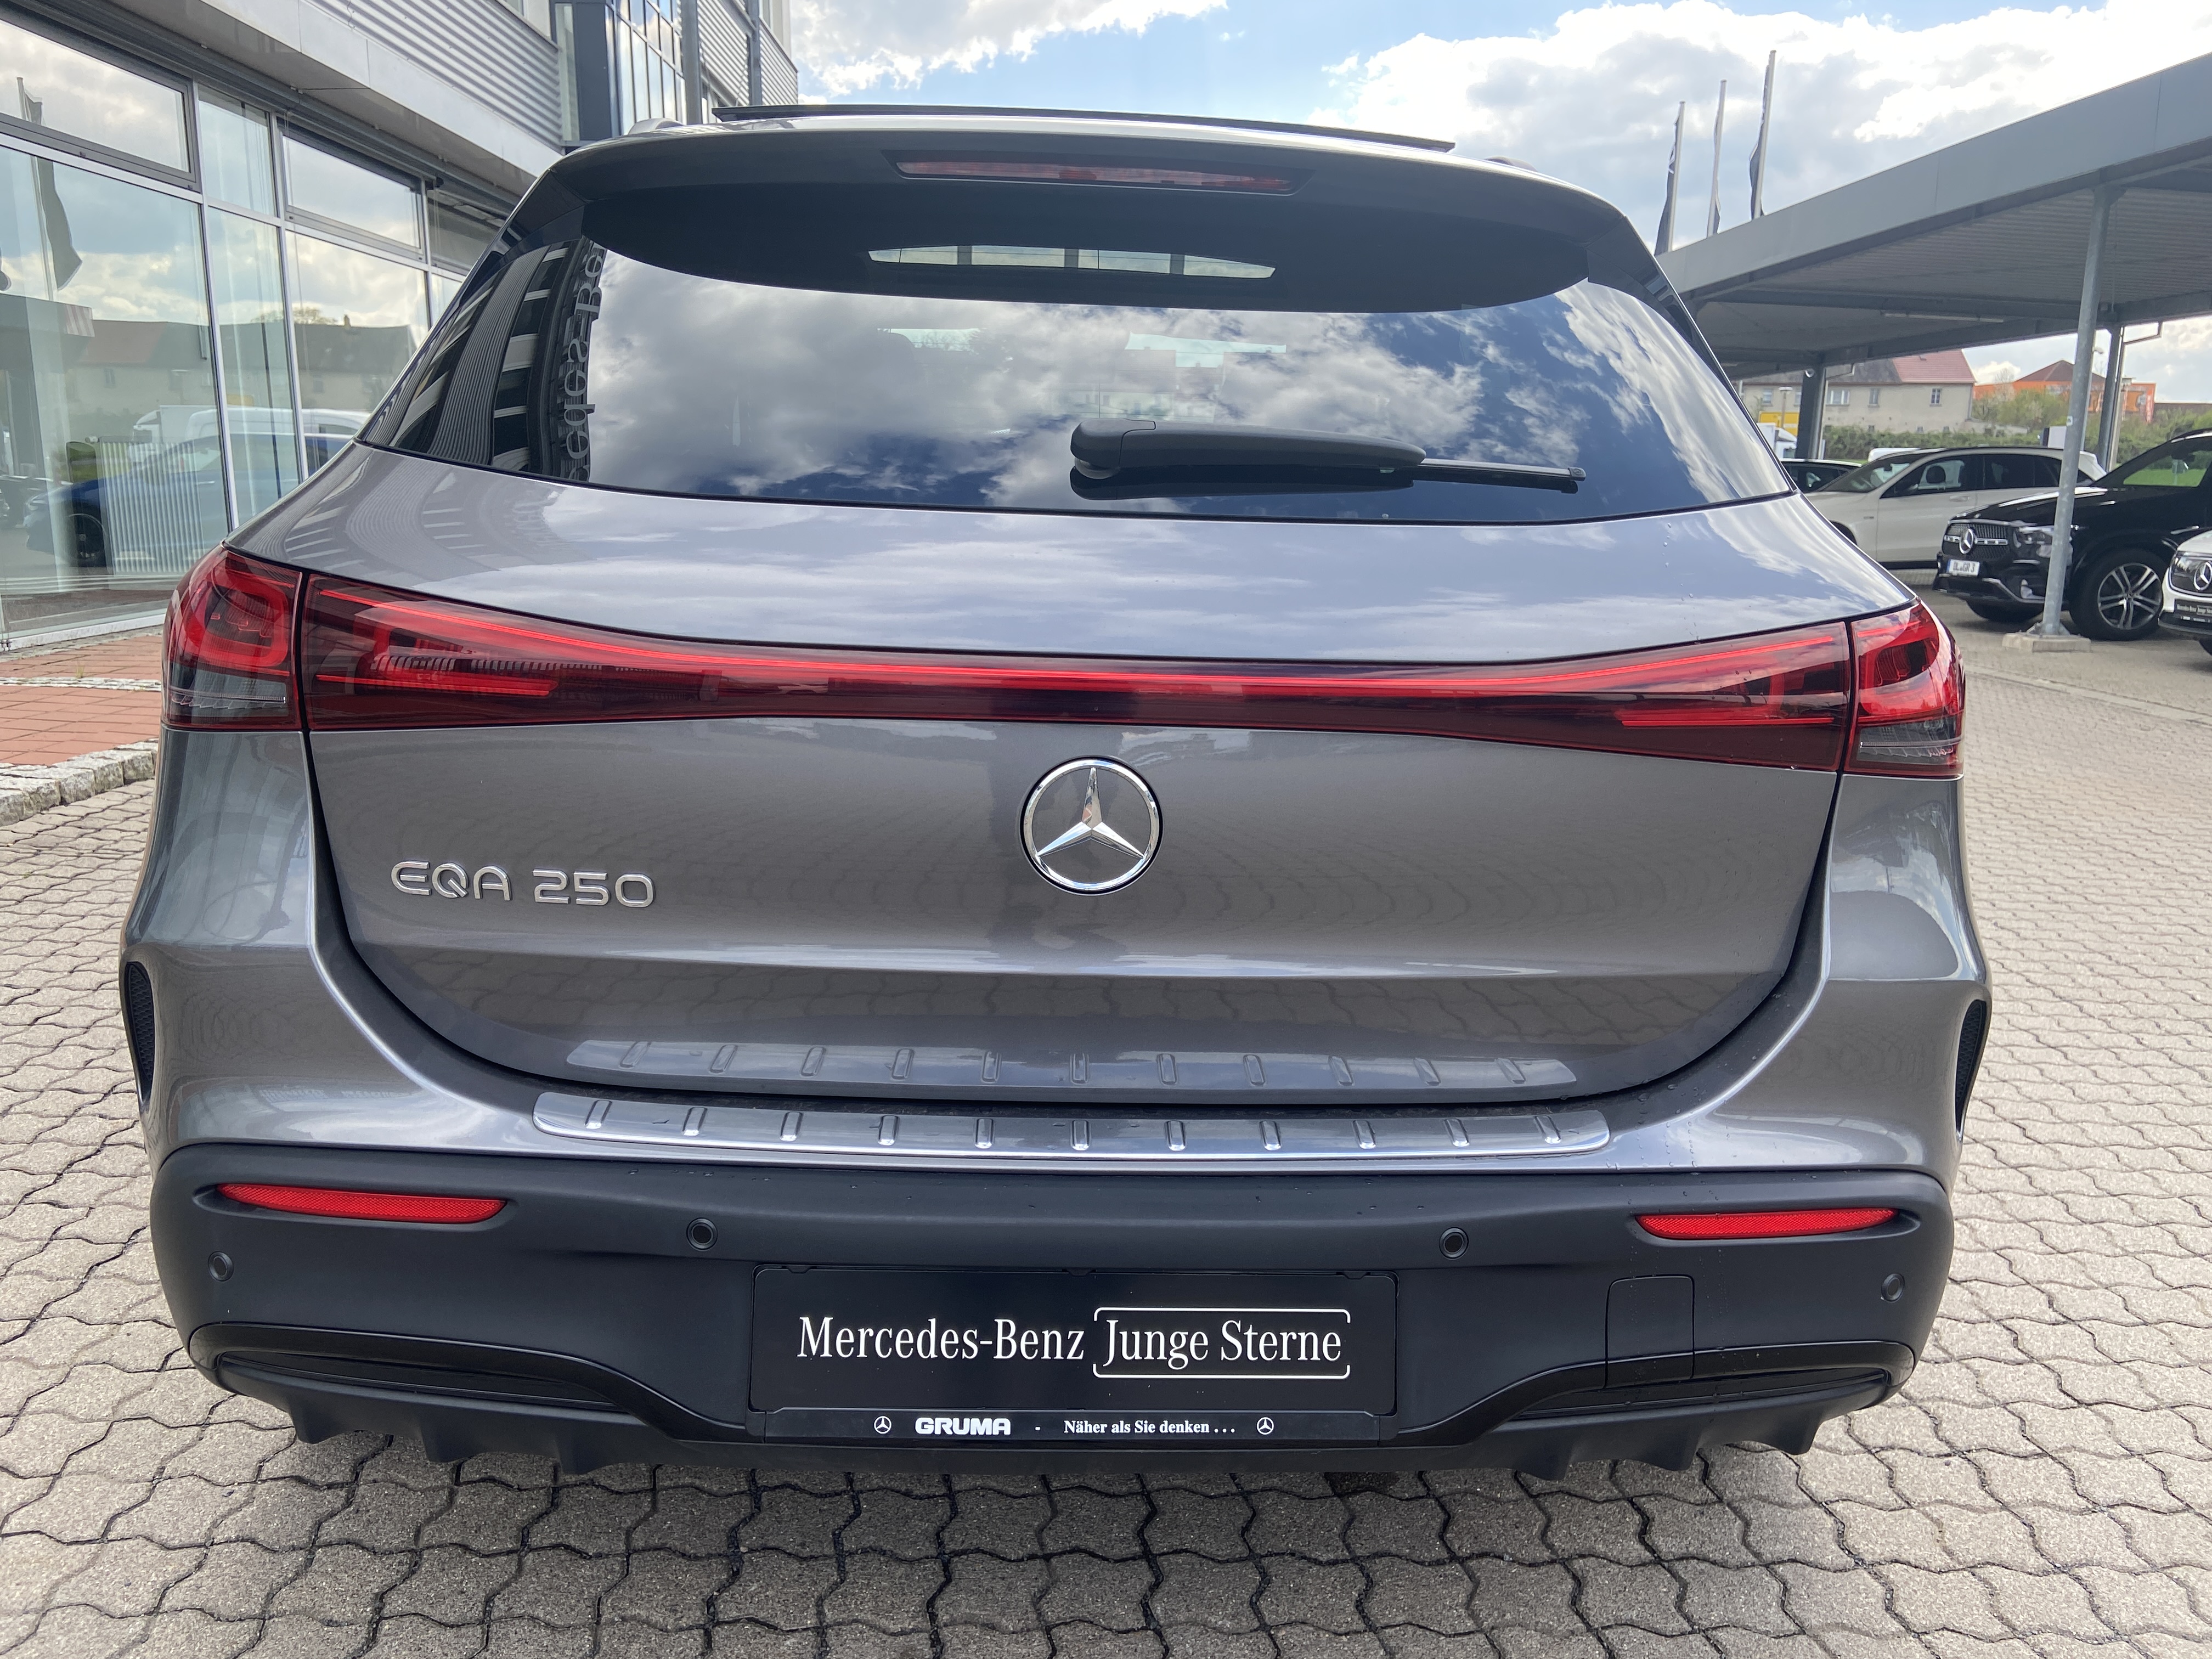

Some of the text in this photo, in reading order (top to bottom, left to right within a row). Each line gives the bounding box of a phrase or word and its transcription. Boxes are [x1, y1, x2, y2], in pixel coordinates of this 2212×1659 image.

[391, 860, 654, 908] EQA 250
[797, 1316, 1341, 1370] Mercedes-Benz Junge Sterne
[915, 1417, 1011, 1435] GRUMA
[1063, 1420, 1108, 1434] Näher
[1111, 1420, 1131, 1434] als
[1134, 1420, 1156, 1434] Sie
[1159, 1420, 1210, 1434] denken
